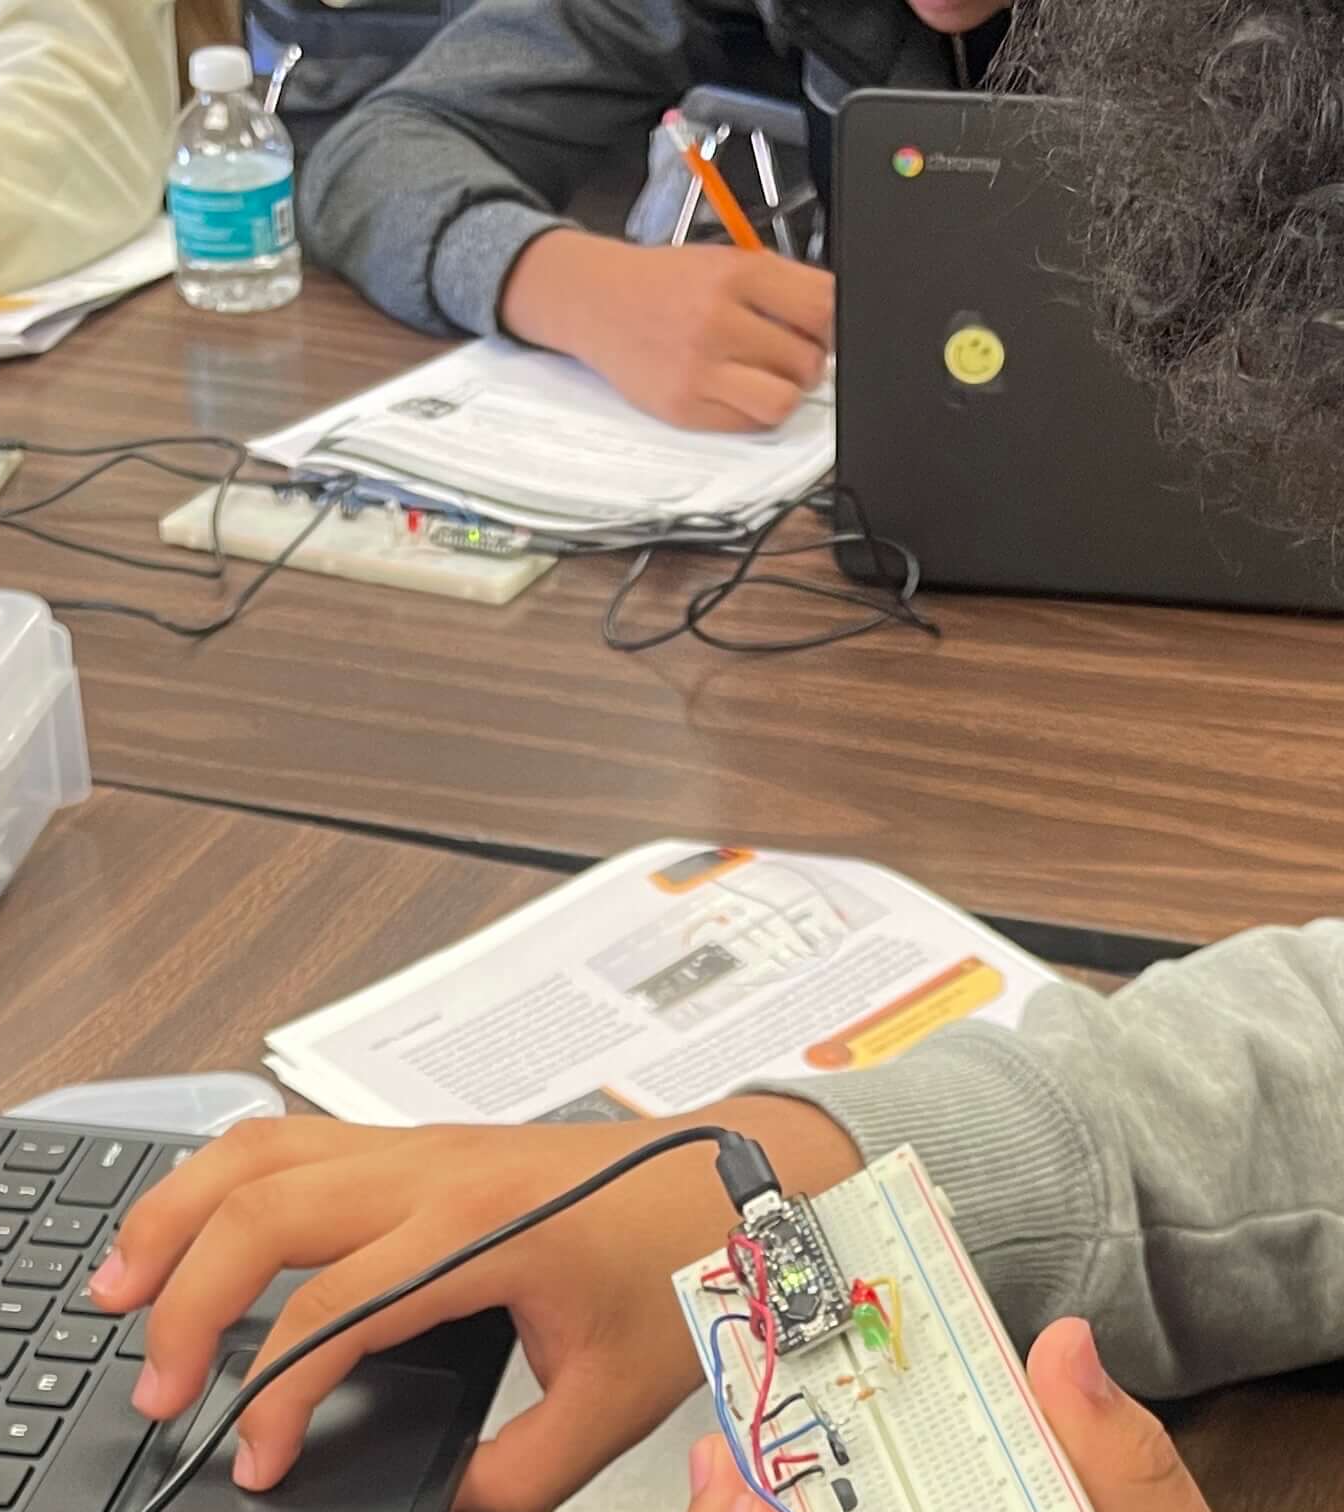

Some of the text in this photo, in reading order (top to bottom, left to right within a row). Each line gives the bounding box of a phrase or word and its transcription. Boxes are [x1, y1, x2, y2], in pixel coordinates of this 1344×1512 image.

[0, 1303, 22, 1312] l
[37, 1374, 58, 1391] m
[9, 1423, 28, 1437] n
